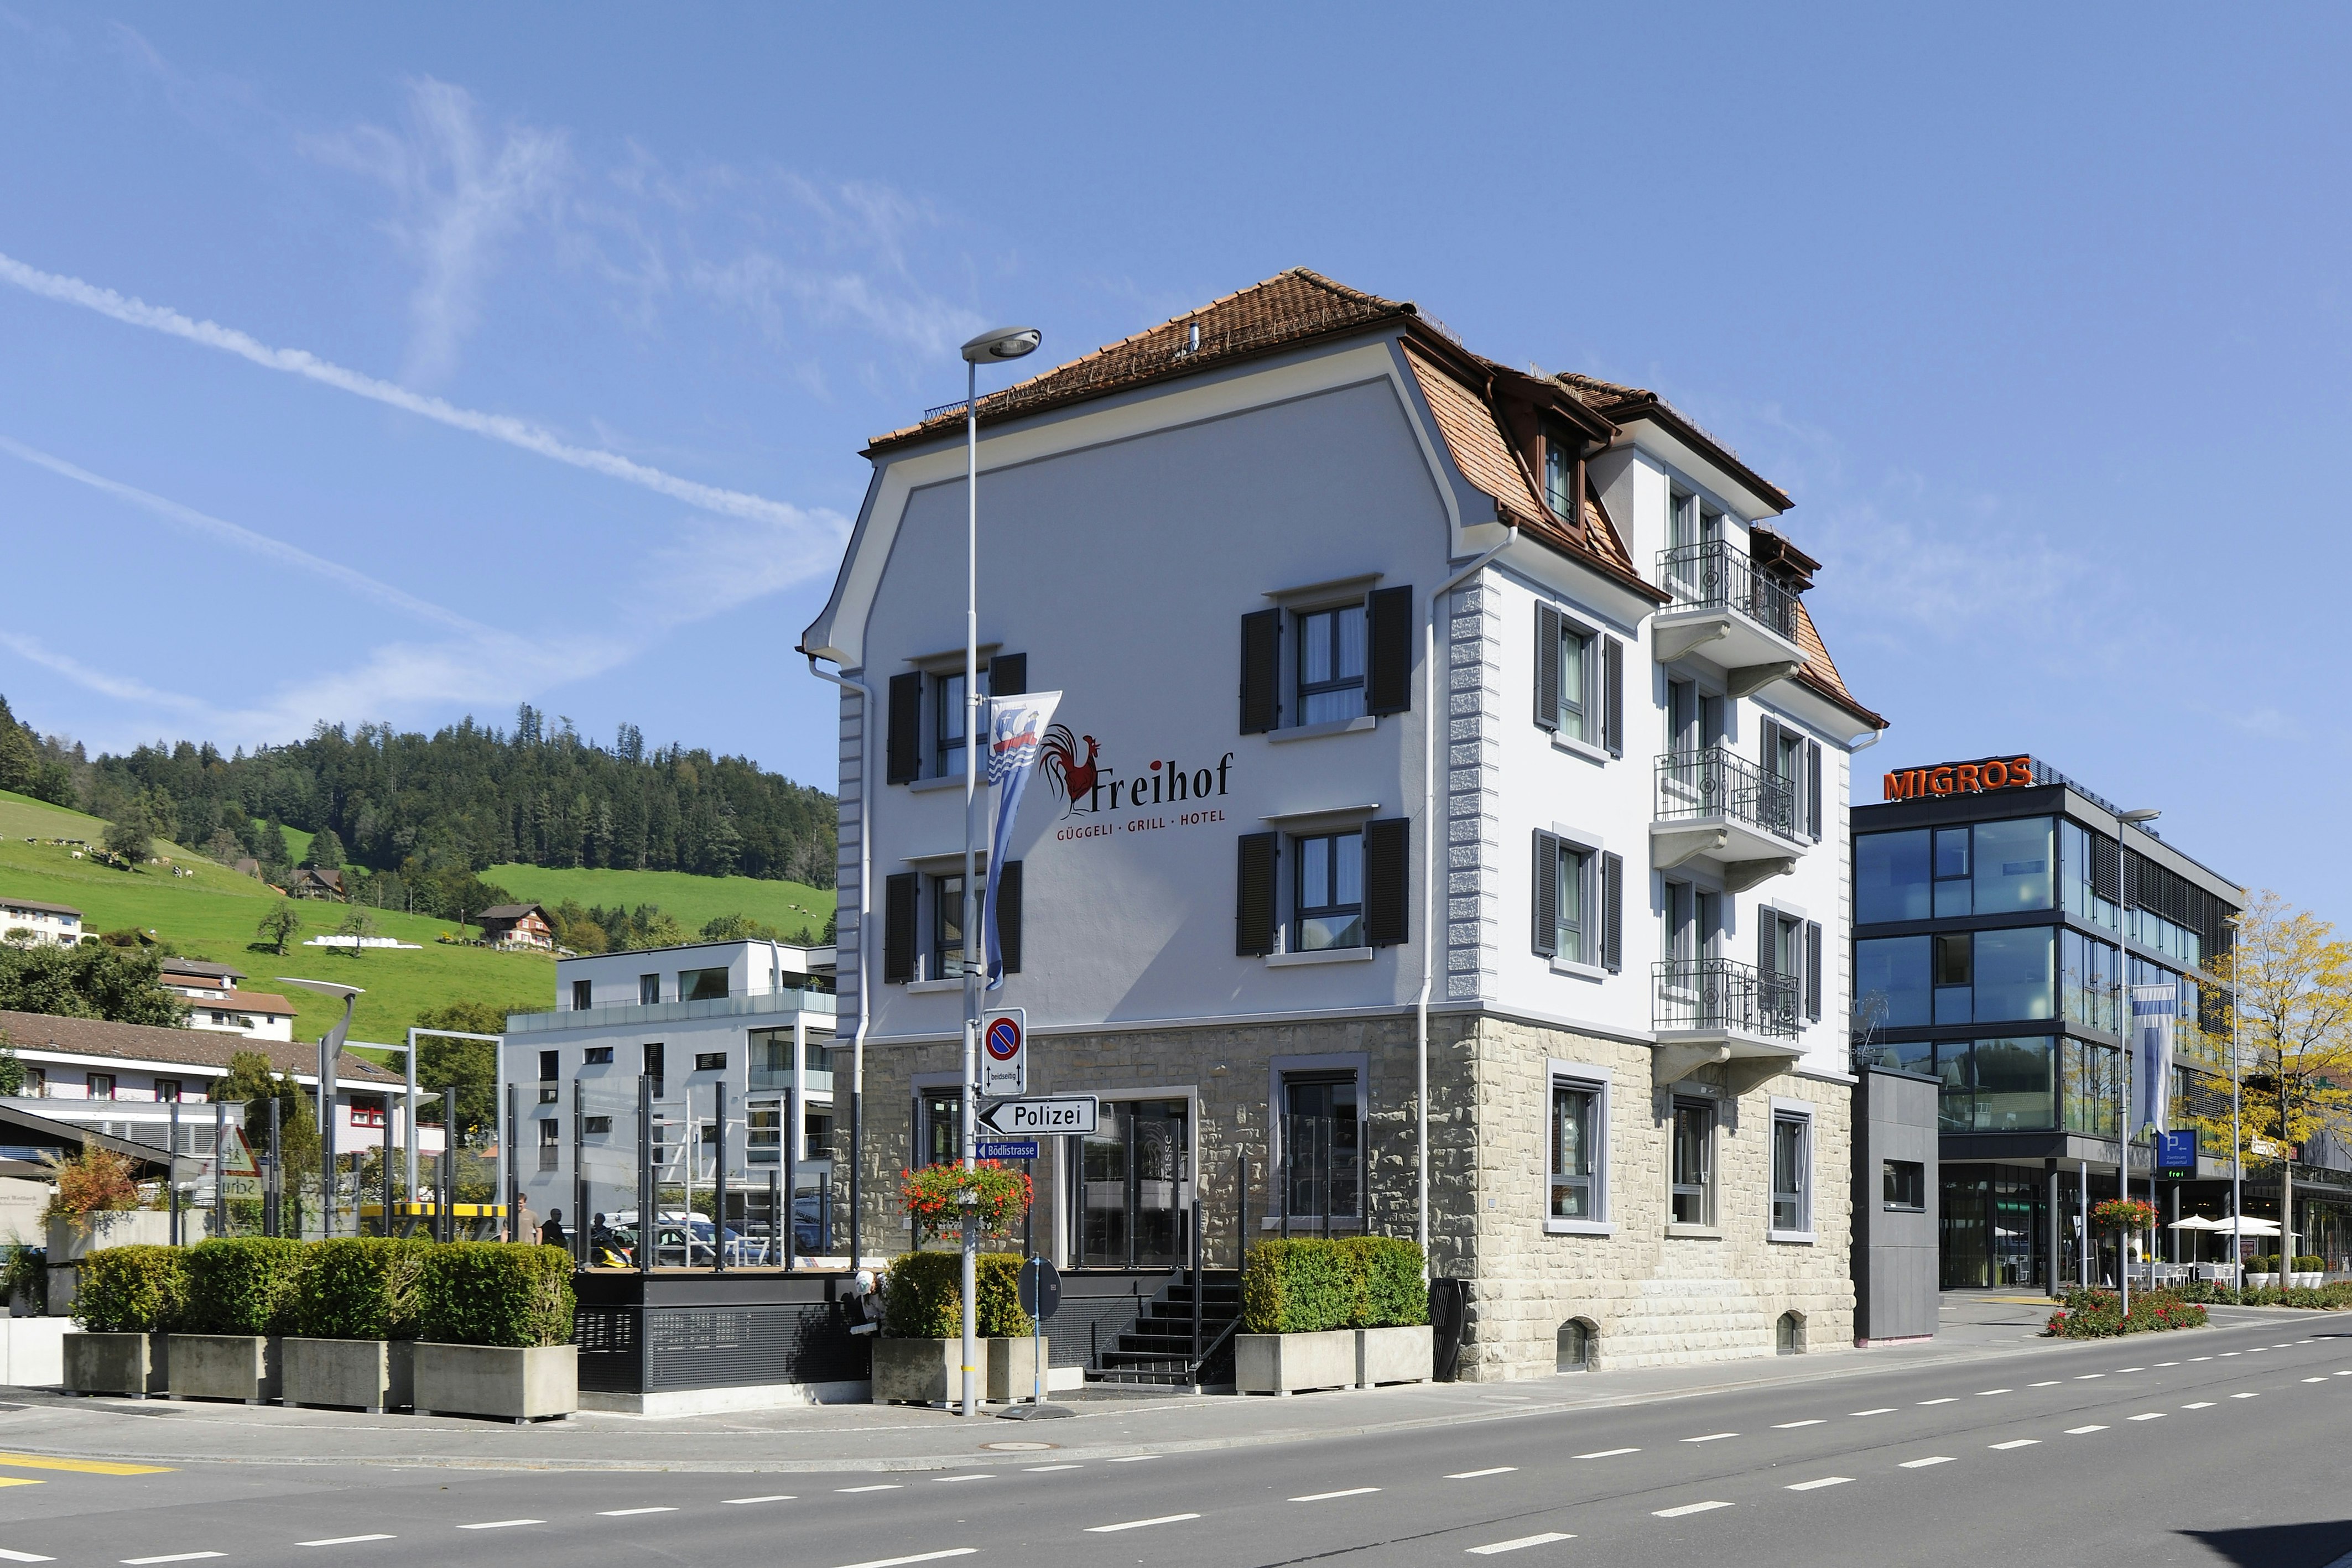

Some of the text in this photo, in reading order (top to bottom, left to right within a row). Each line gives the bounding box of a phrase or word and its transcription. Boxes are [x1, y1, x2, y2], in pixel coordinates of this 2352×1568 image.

[1090, 752, 1234, 812] Freihof
[1883, 758, 2032, 800] MIGROS
[1057, 810, 1225, 841] GÜGGELI GRILL HOTEL
[1014, 1105, 1080, 1126] Polizei
[988, 1145, 1034, 1156] Bödlistrasse
[2167, 1136, 2178, 1151] P
